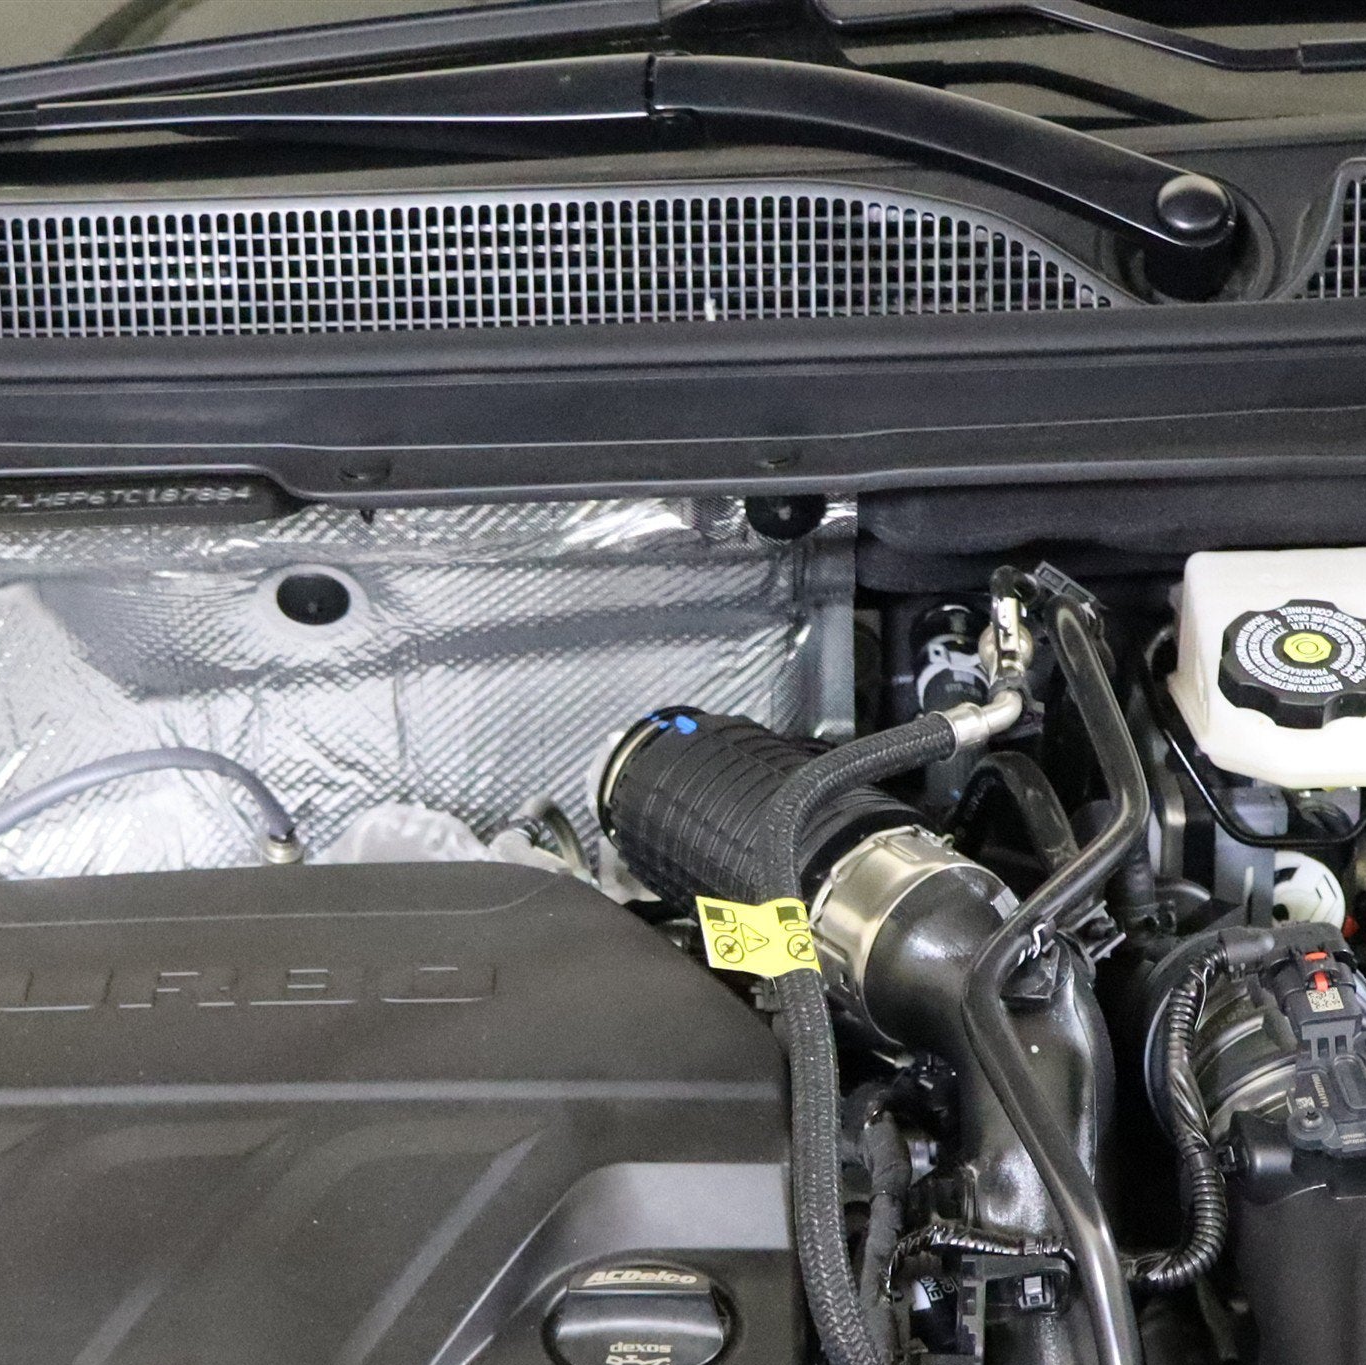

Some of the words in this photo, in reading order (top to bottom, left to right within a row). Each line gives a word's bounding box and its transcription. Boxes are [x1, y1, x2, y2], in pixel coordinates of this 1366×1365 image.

[1286, 614, 1309, 622] ONLY
[583, 1270, 697, 1287] ACDelco
[609, 1341, 673, 1353] dexos
